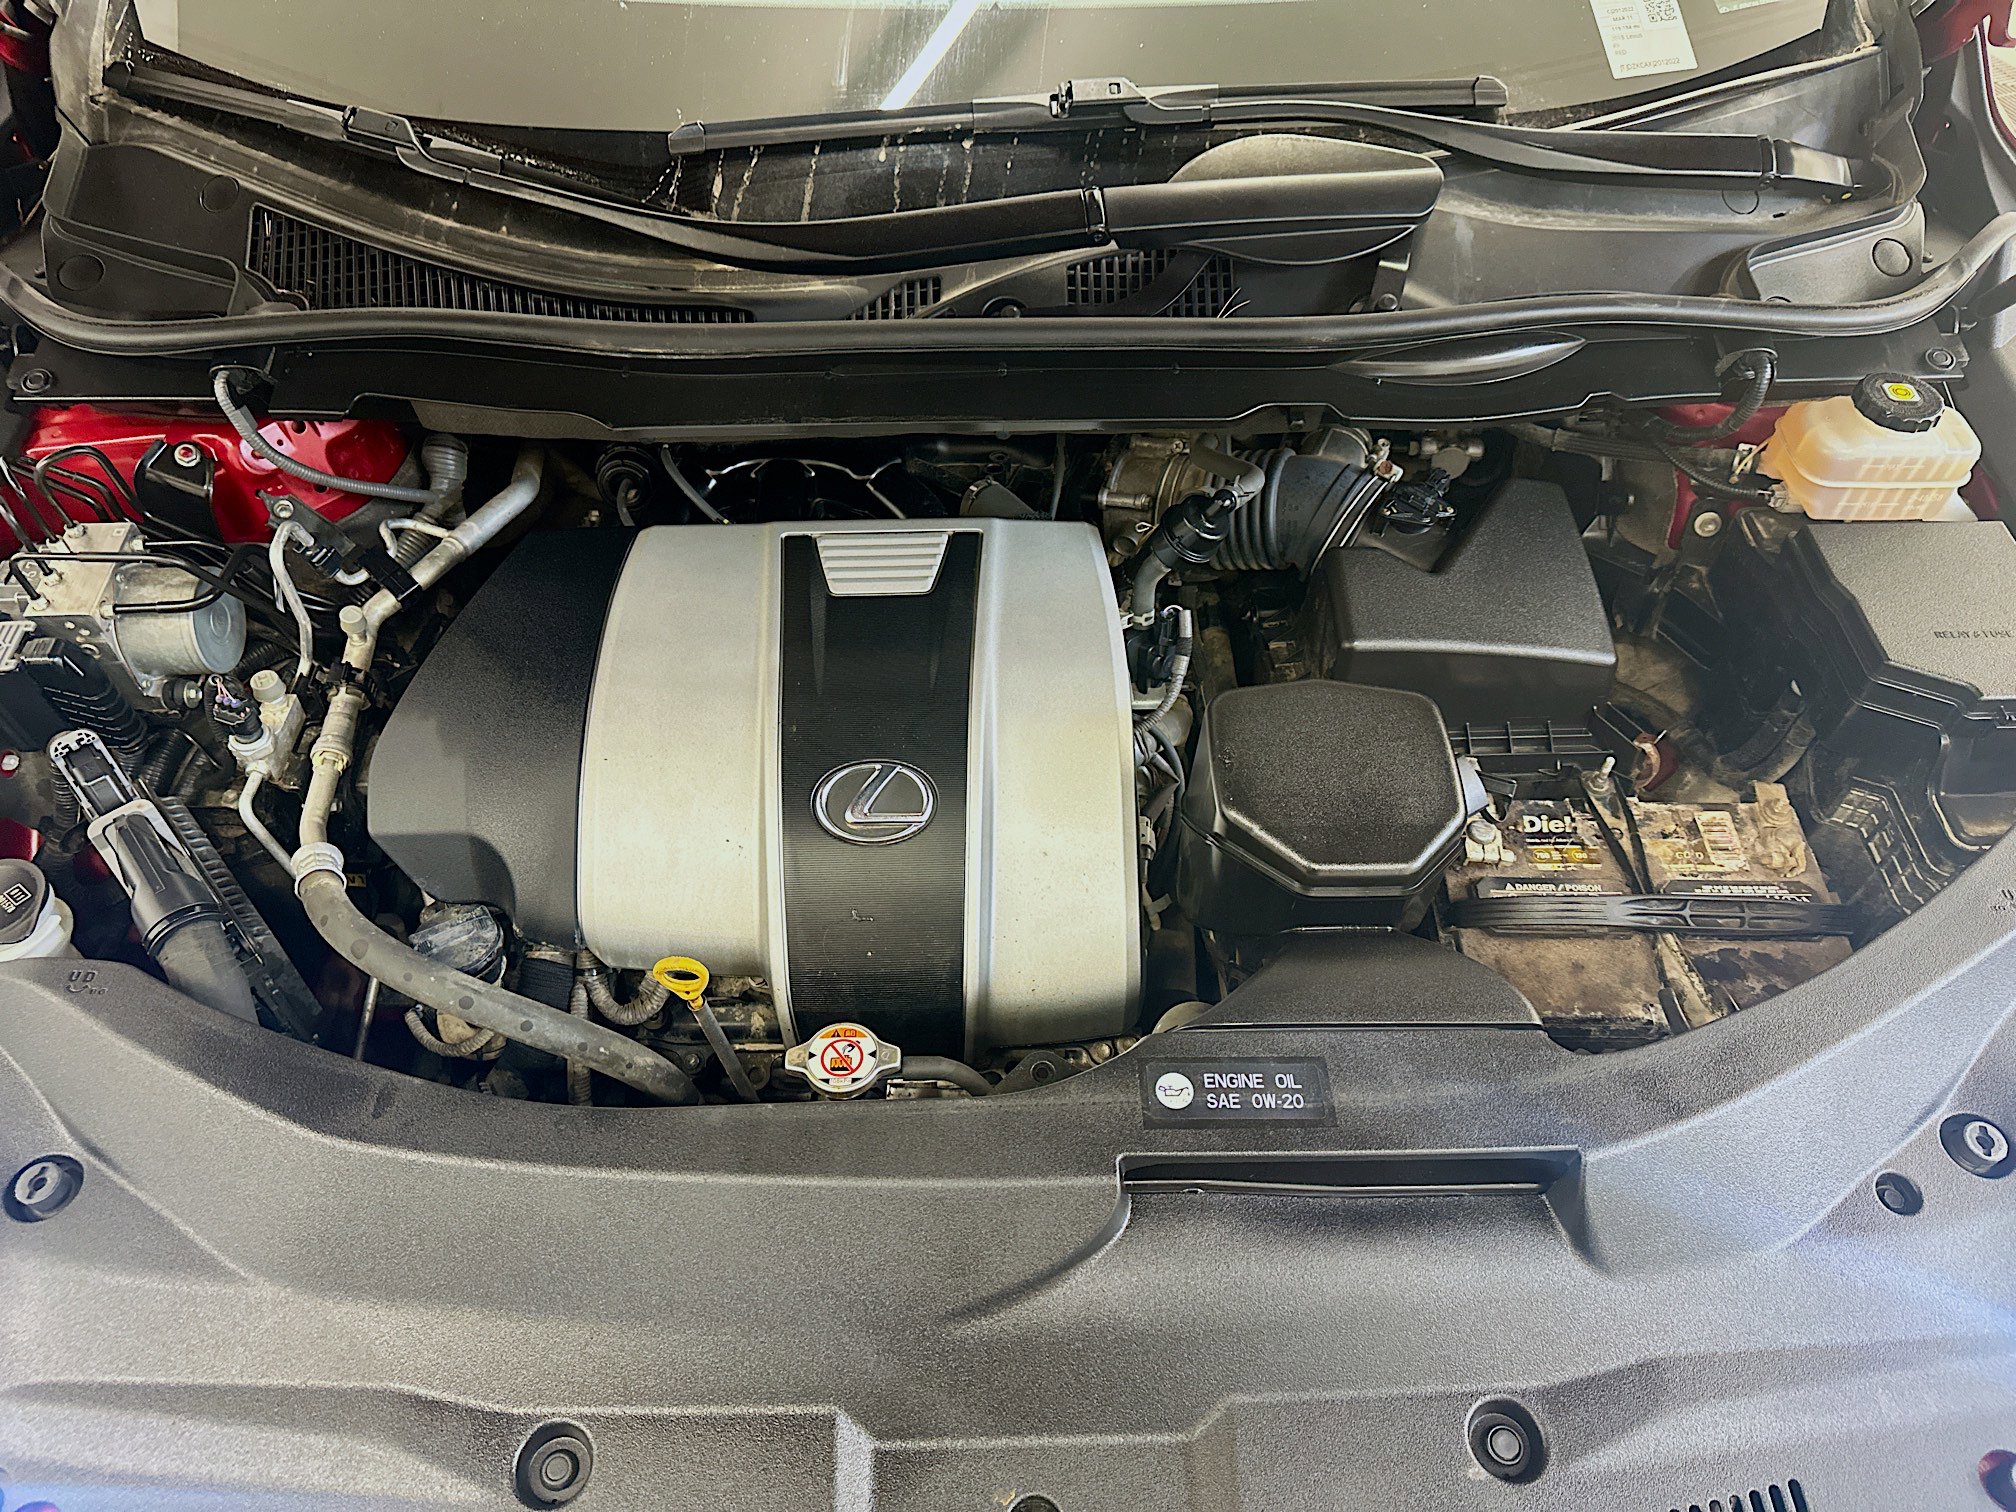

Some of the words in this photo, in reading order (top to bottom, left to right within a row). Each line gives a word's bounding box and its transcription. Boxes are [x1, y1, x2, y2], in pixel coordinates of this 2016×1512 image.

[1933, 630, 1970, 639] RELAY
[1515, 883, 1556, 892] DANGER
[1564, 883, 1602, 893] POISON
[1204, 1074, 1264, 1088] ENGINE
[1275, 1074, 1303, 1089] OIL
[1207, 1094, 1241, 1108] SAE
[1253, 1094, 1304, 1108] 0W-20
